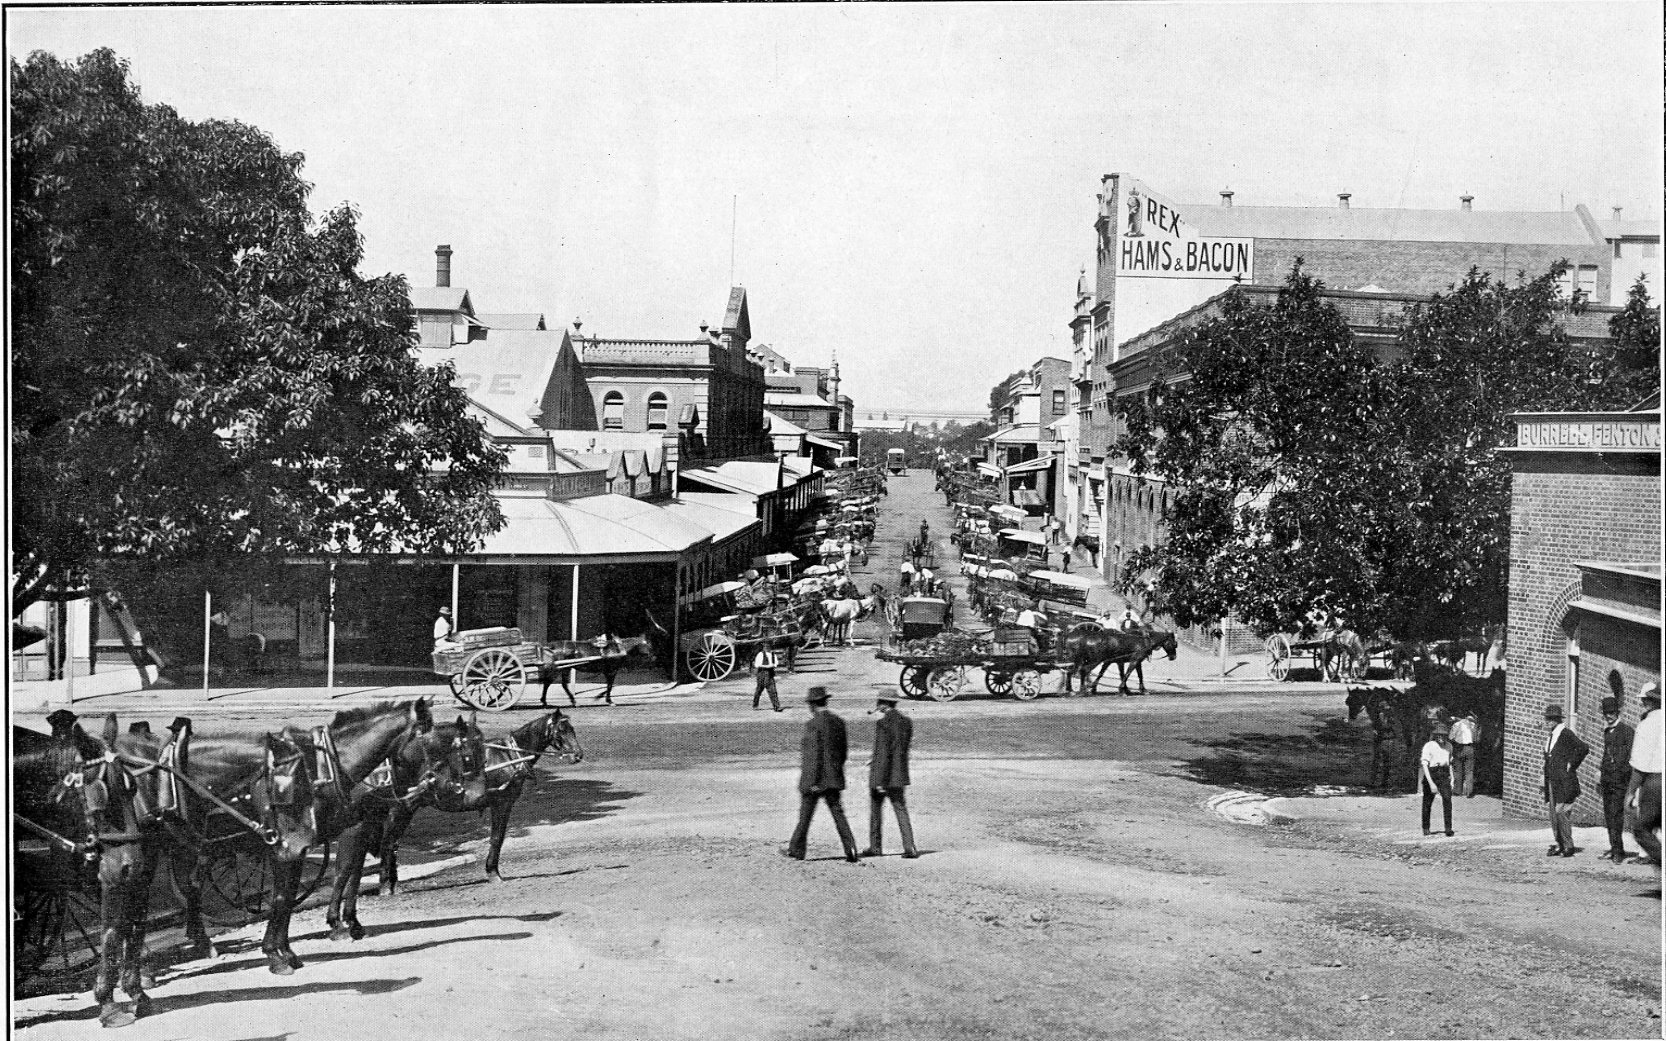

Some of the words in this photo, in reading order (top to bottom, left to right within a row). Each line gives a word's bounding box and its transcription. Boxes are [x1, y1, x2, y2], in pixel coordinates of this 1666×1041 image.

[1122, 240, 1171, 270] HAMS
[1174, 258, 1184, 271] &
[1187, 241, 1248, 272] BACON
[1592, 423, 1650, 446] FENTON
